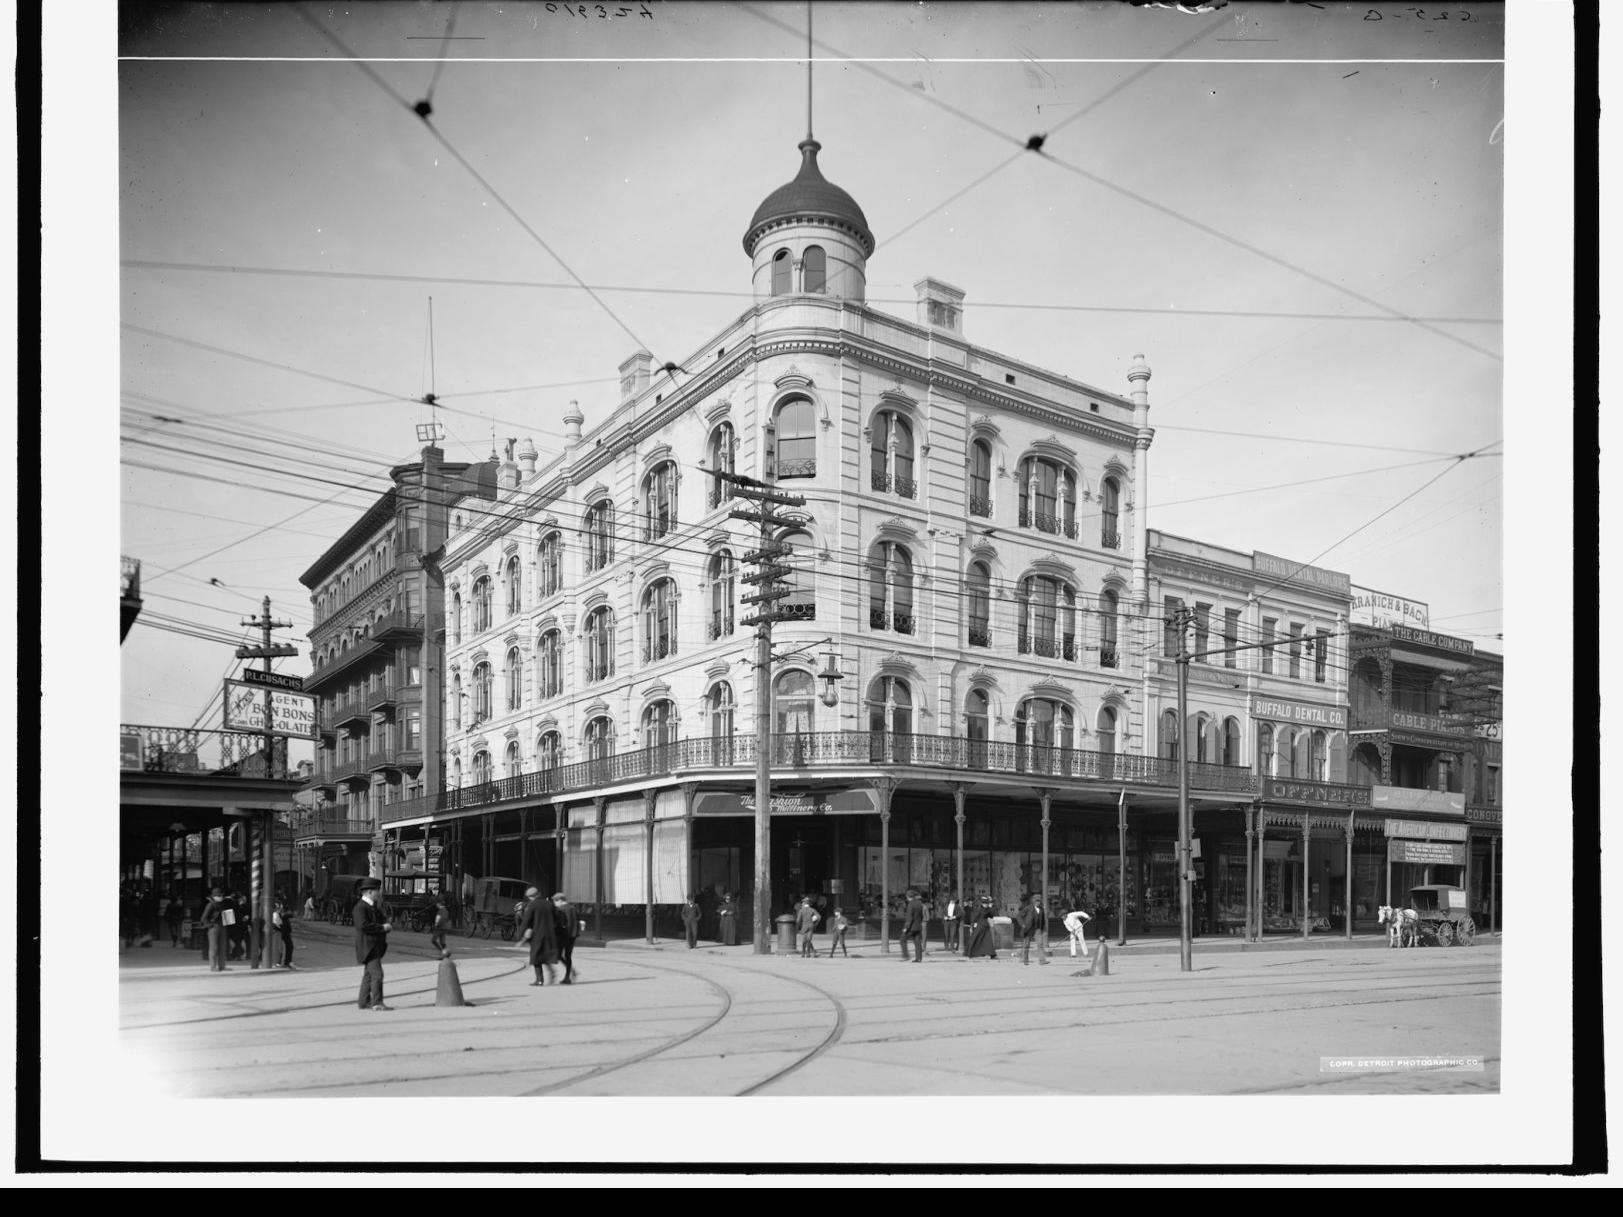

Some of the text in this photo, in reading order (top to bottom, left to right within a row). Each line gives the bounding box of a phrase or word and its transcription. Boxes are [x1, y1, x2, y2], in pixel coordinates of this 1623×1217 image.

[1255, 555, 1286, 576] BUFFALO
[1352, 594, 1427, 626] KRANICH & BACH
[1395, 626, 1473, 653] THE CABLE COMPANY
[282, 708, 316, 721] BONS
[1256, 701, 1344, 725] BUFFALO DENTAL CO.
[1393, 712, 1427, 729] CABLE
